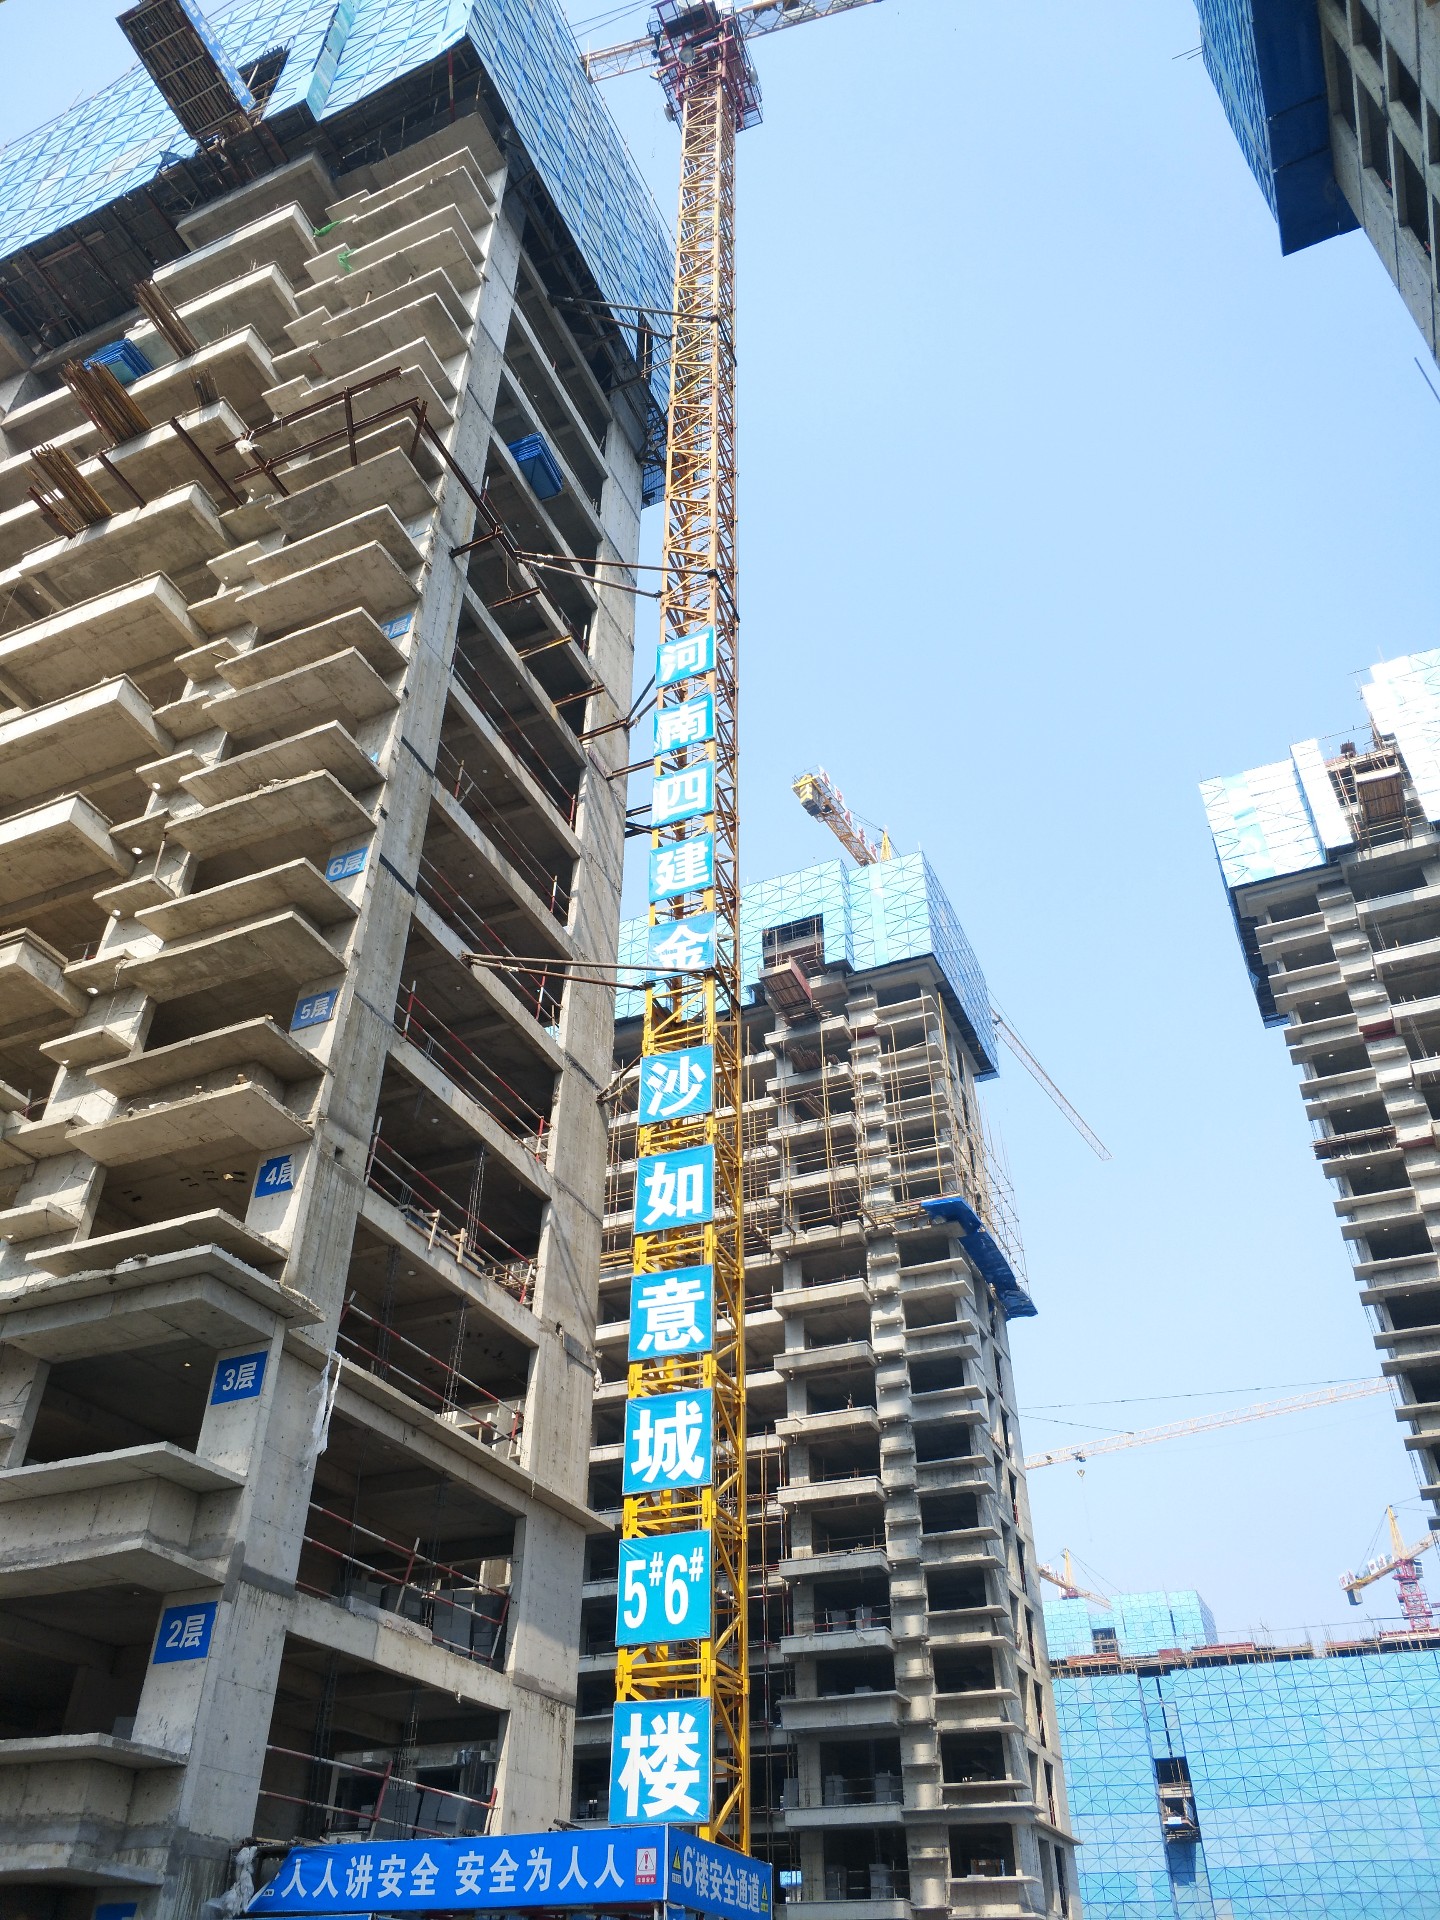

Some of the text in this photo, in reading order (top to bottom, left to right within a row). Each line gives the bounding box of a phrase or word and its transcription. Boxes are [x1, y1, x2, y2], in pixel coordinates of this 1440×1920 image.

[329, 852, 363, 877] 6层
[300, 996, 330, 1020] 5层
[265, 1162, 292, 1186] 4层
[222, 1361, 257, 1391] 3层
[165, 1613, 206, 1649] 2层
[281, 1844, 625, 1899] 人人讲安全 安全为人人
